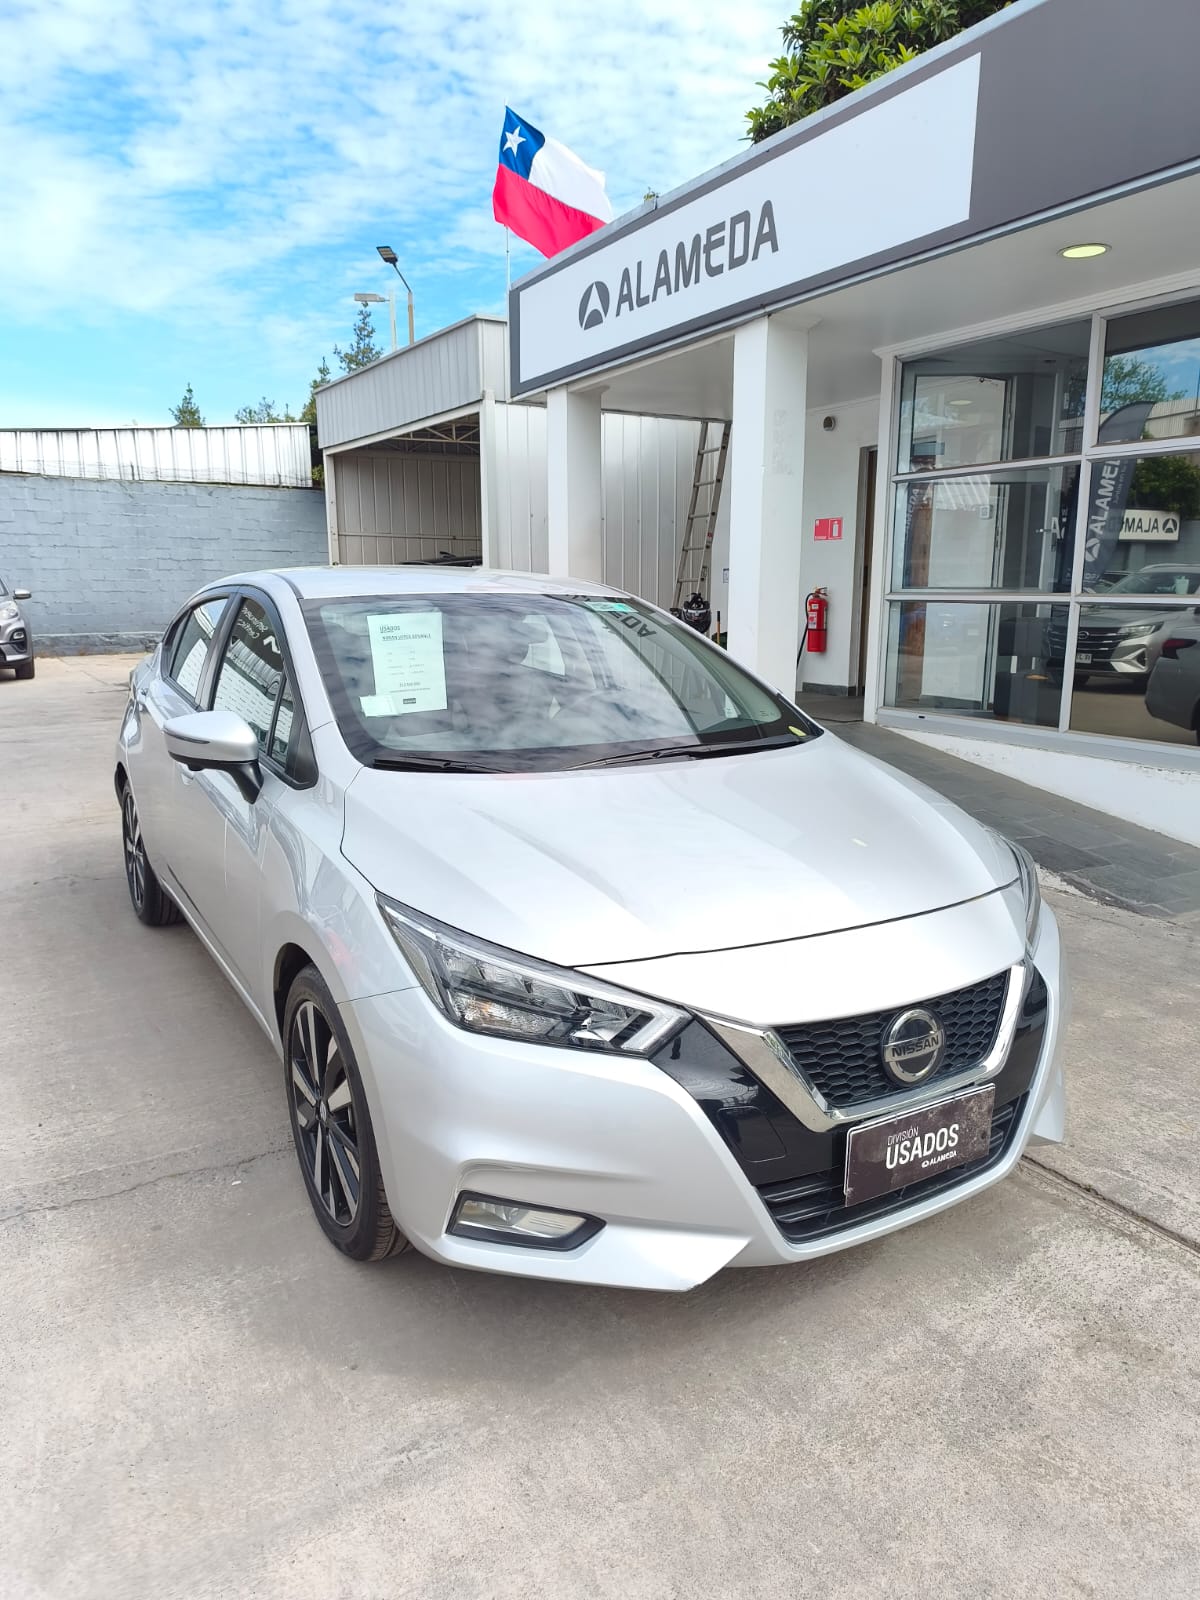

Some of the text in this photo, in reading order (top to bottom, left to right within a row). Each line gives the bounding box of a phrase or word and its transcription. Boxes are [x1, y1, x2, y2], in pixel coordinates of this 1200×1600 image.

[616, 200, 779, 317] ALAMEDA
[891, 1035, 939, 1058] NISSAN
[886, 1123, 960, 1169] USADOS
[887, 1125, 919, 1146] DIVISIÓN
[929, 1150, 957, 1166] ALAMEDA
